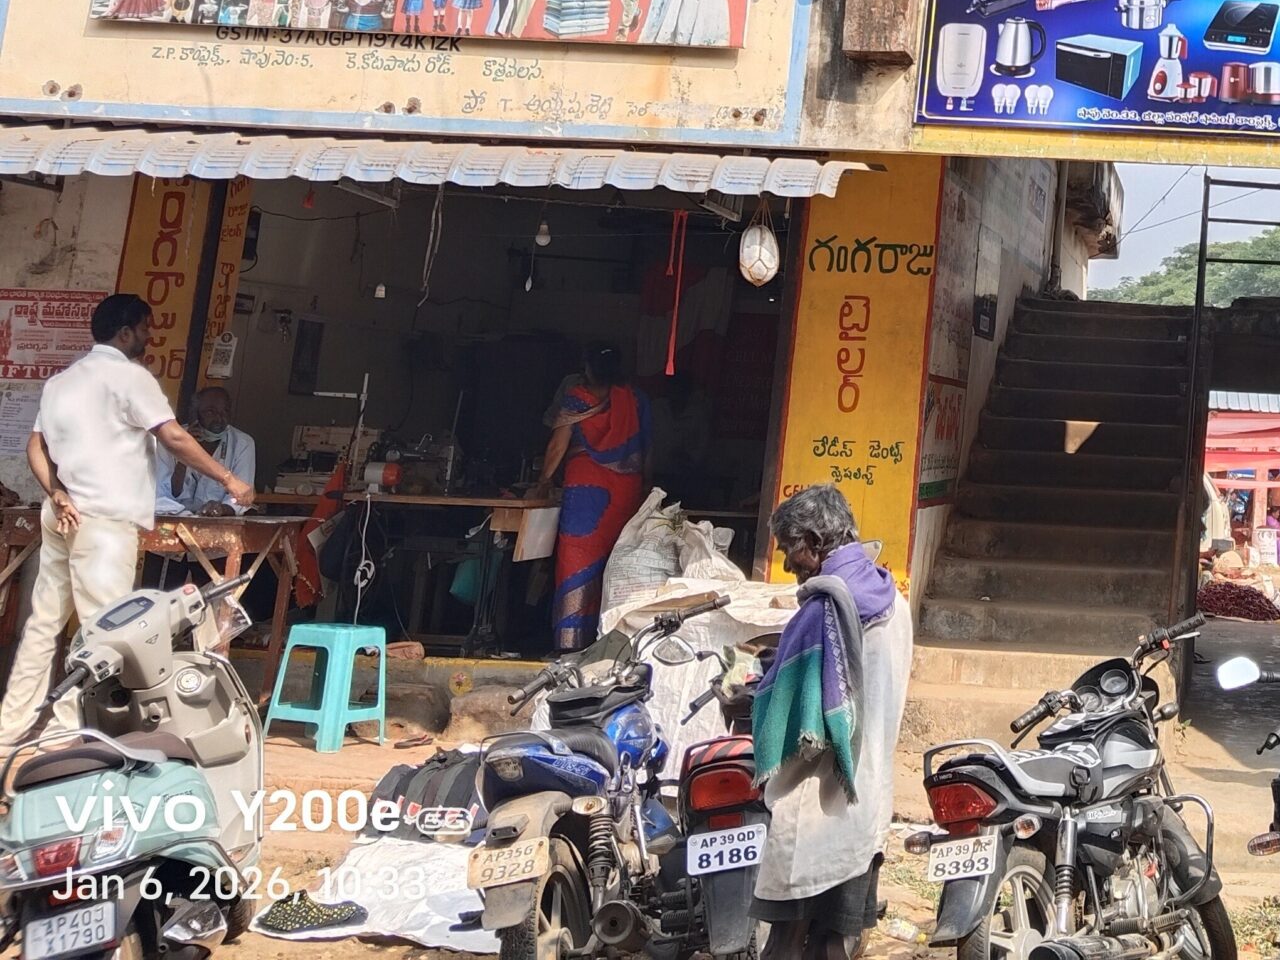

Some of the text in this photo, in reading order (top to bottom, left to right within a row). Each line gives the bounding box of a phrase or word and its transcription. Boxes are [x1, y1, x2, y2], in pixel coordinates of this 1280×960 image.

[808, 234, 935, 277] గంగరాజు
[838, 295, 870, 413] టైలర్
[700, 830, 755, 849] AP 39 QD
[698, 845, 757, 869] 8186
[937, 844, 970, 859] AP 39
[481, 860, 535, 882] 9328
[934, 857, 989, 878] 8393
